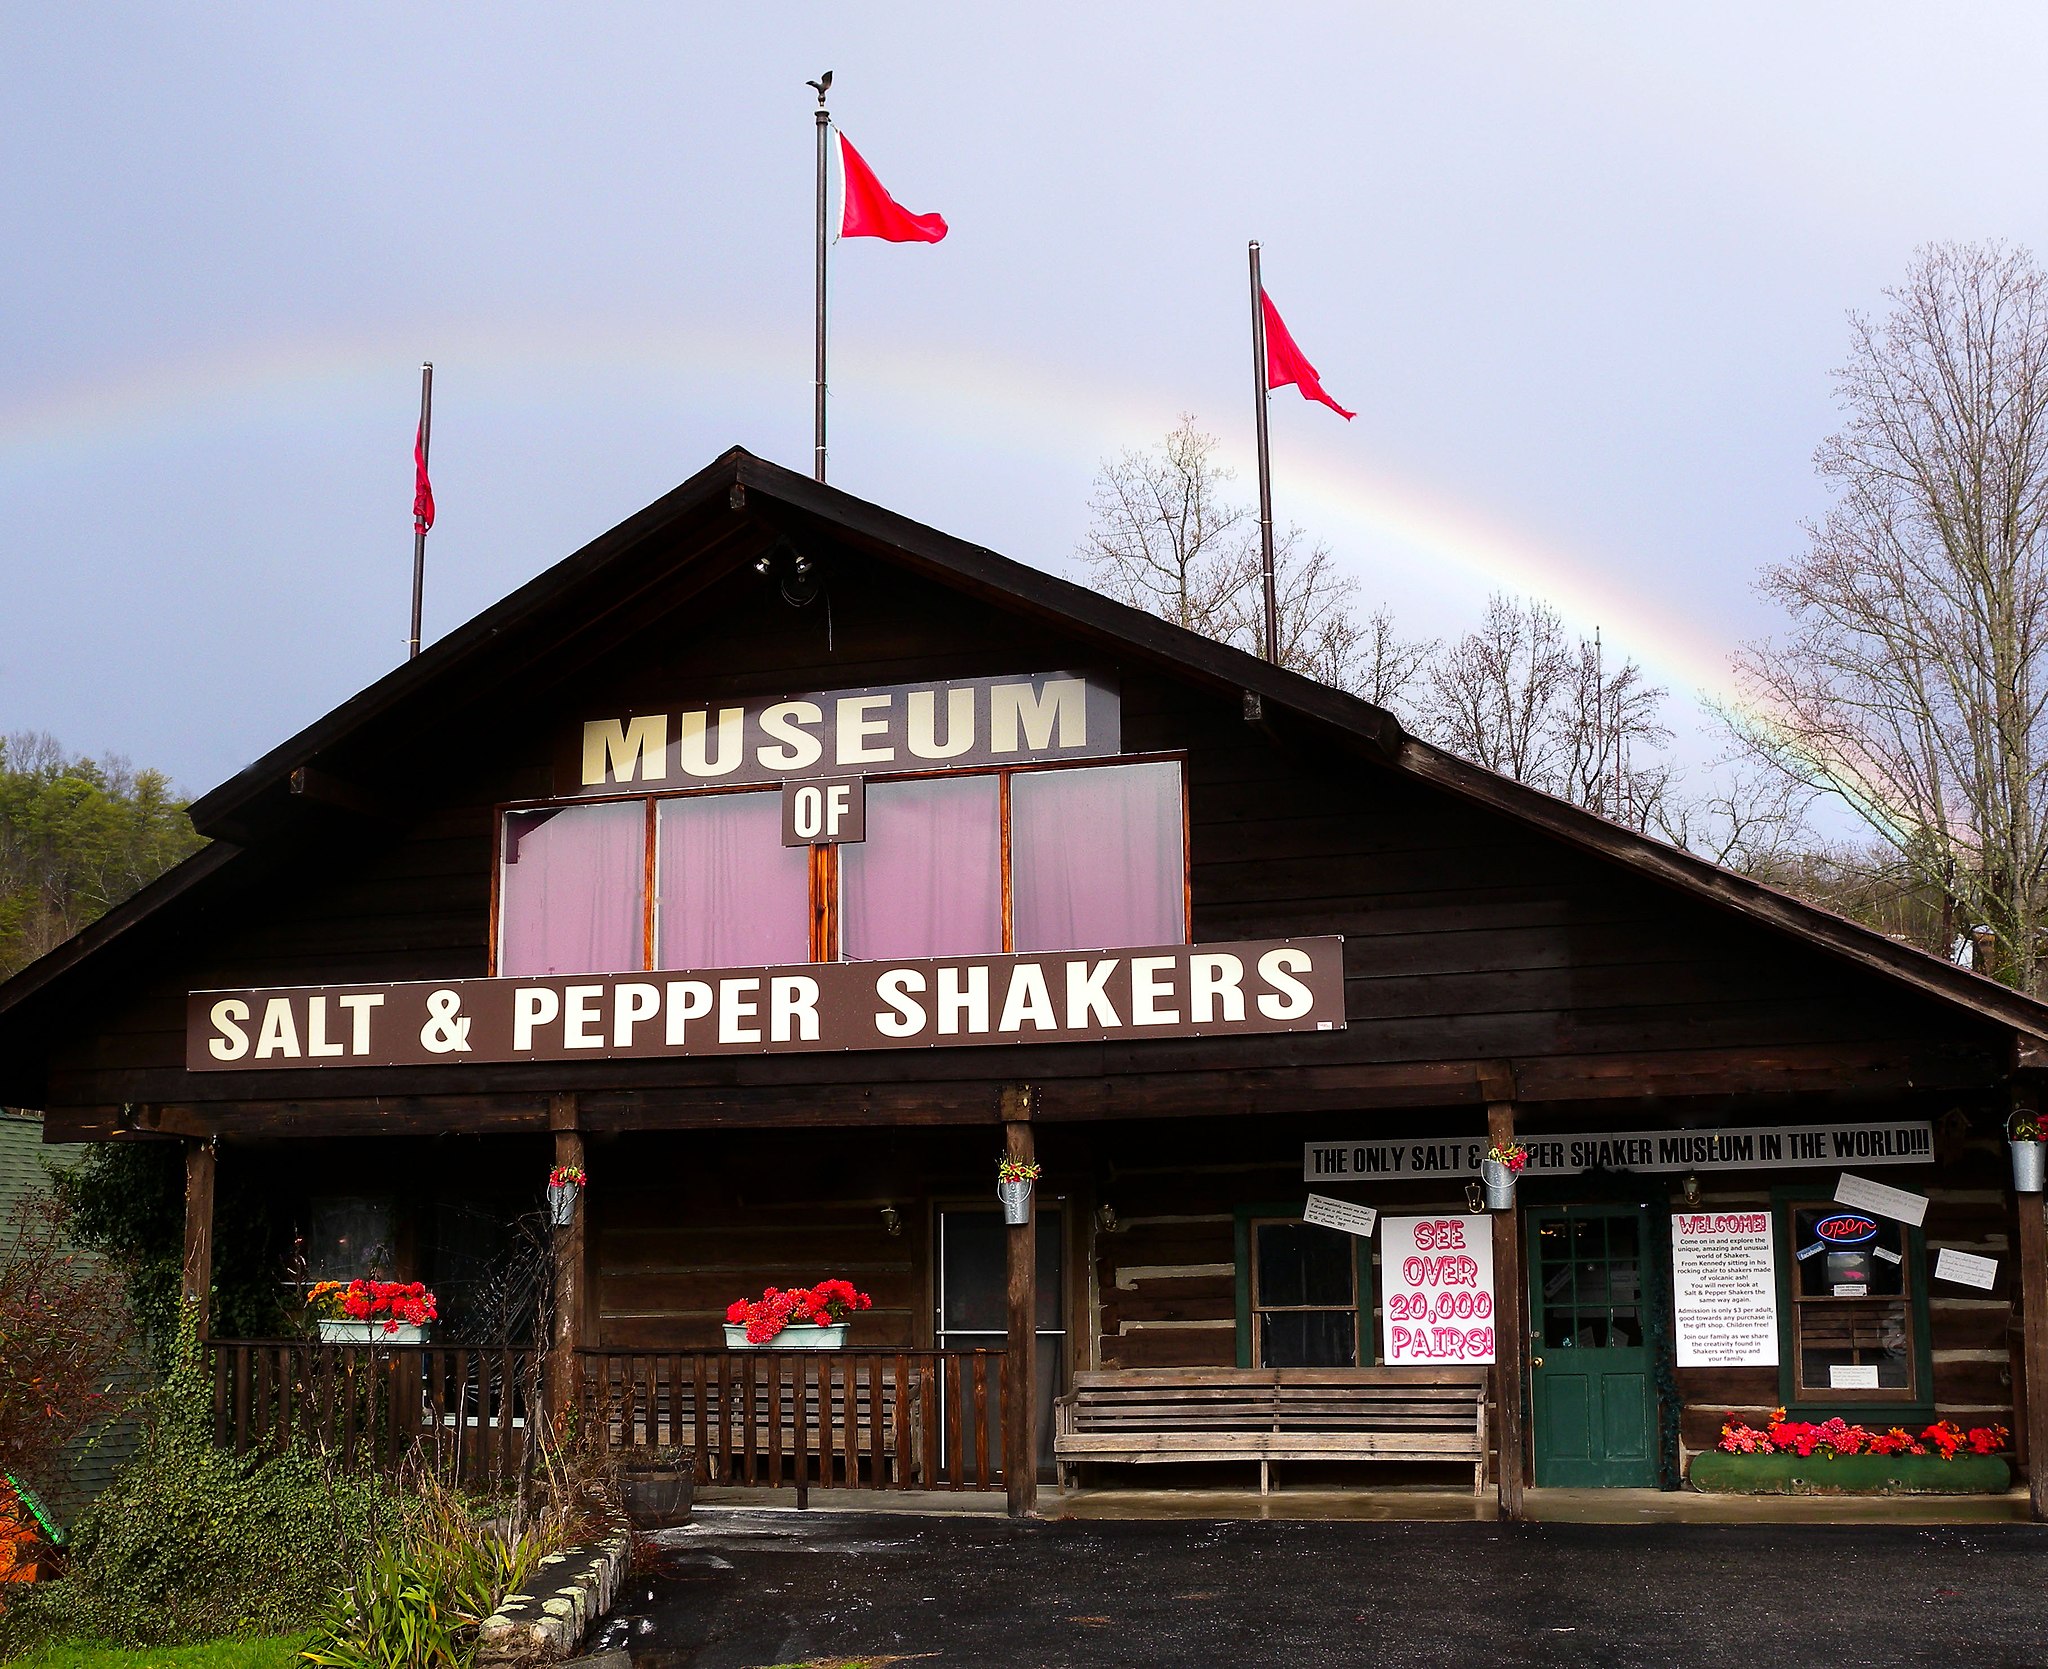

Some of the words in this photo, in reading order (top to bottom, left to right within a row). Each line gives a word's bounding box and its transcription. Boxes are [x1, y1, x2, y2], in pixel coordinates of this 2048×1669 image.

[581, 678, 1088, 786] MUSEUM
[792, 784, 850, 838] OF
[208, 993, 385, 1061] SALT
[419, 988, 473, 1053] &
[513, 974, 820, 1052] PEPPER
[874, 947, 1316, 1039] SHAKERS
[1313, 1148, 1348, 1174] THE
[1353, 1146, 1406, 1173] ONLY
[1411, 1144, 1462, 1171] SALT
[1467, 1143, 1482, 1170] &
[1570, 1138, 1653, 1168] SHAKER
[1658, 1133, 1754, 1164] MUSEUM
[1758, 1133, 1783, 1161] IN
[1787, 1131, 1828, 1160] THE
[1831, 1127, 1930, 1158] WORLD!!!
[1413, 1219, 1467, 1251] SEE
[1678, 1213, 1767, 1235] WELCOME!
[1402, 1254, 1479, 1289] OVER
[1388, 1290, 1493, 1325] 20,000
[1391, 1325, 1494, 1360] PAIRS!
